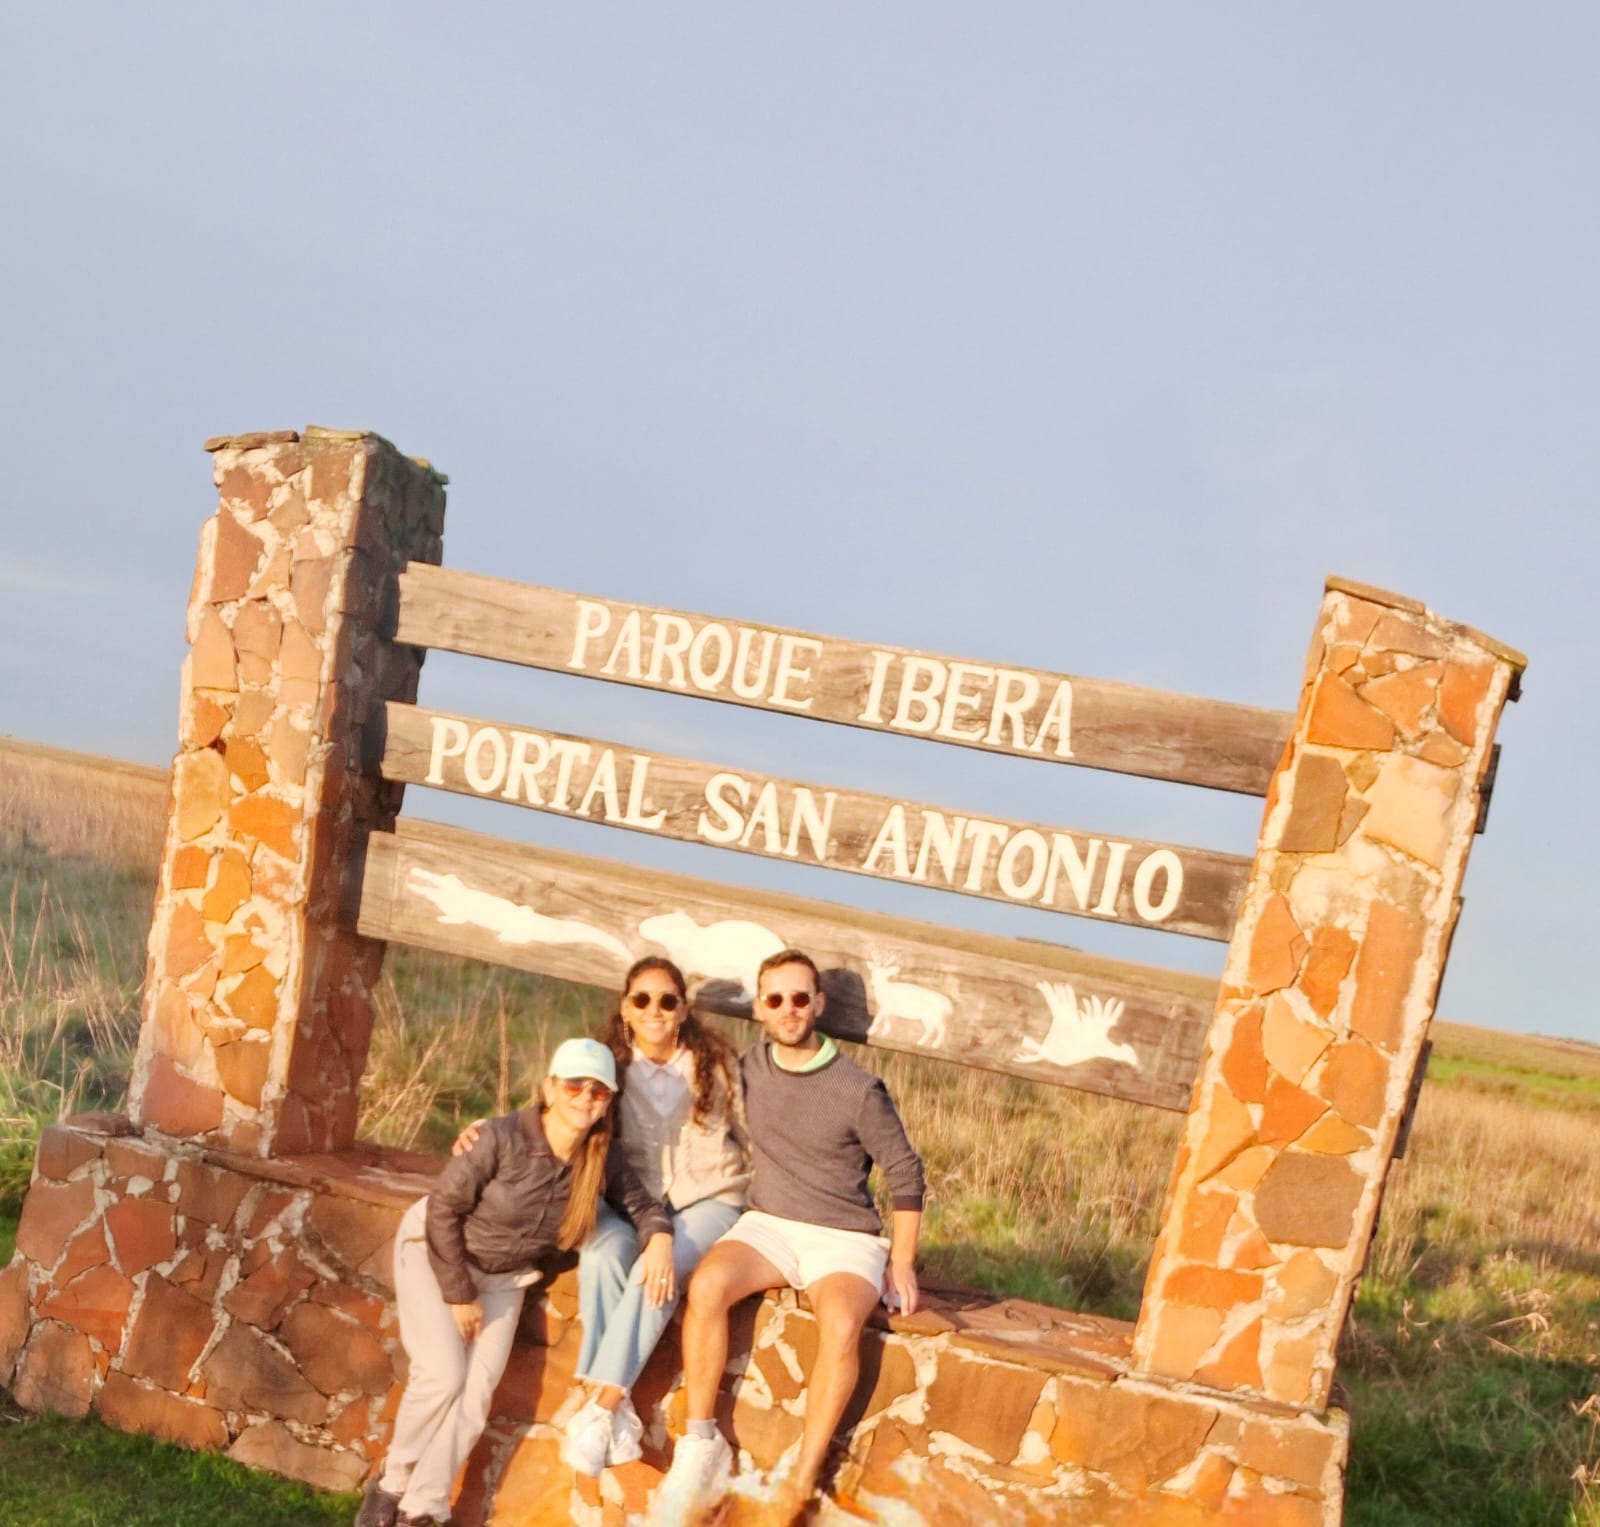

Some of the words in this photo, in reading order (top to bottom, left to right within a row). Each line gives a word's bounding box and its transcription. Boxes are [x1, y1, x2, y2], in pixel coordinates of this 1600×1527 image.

[567, 600, 823, 711] PARQUE
[858, 650, 1075, 758] IBERA
[424, 716, 668, 829] PORTAL
[697, 772, 838, 862] SAN
[861, 804, 1184, 922] ANTONIO
